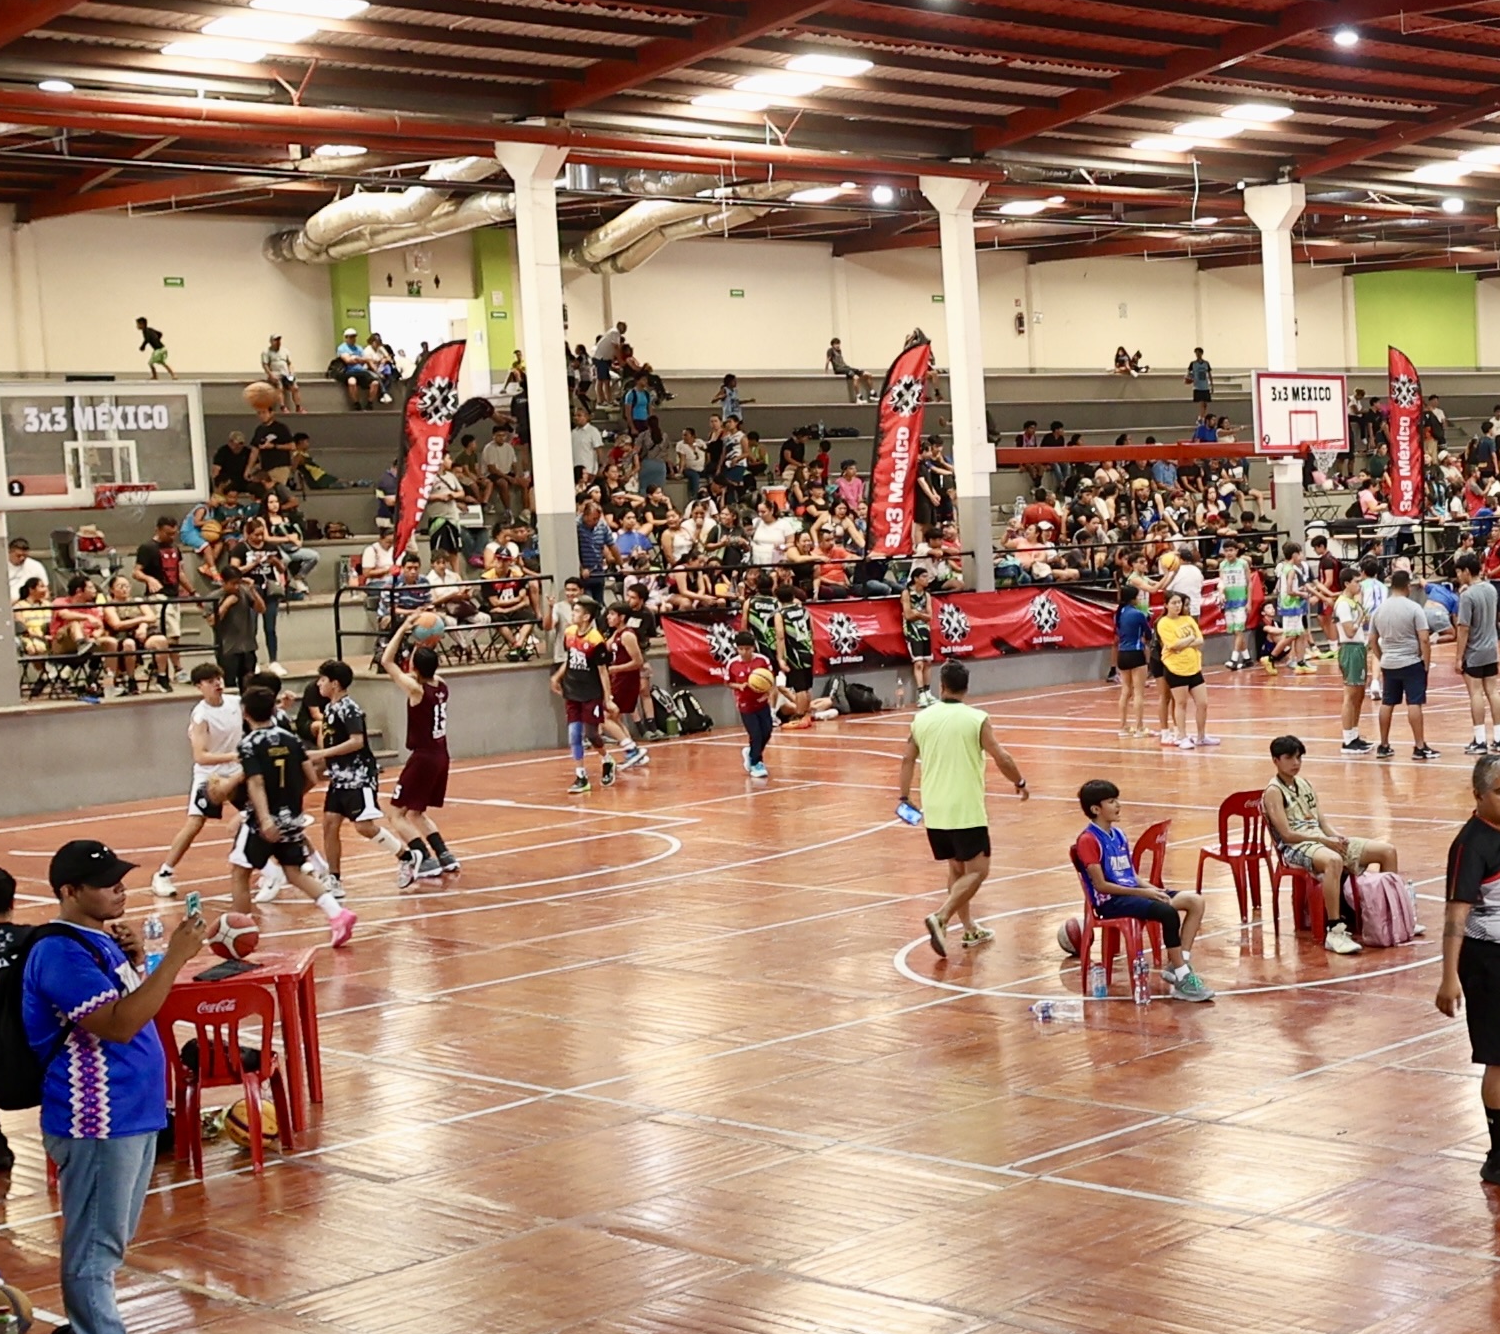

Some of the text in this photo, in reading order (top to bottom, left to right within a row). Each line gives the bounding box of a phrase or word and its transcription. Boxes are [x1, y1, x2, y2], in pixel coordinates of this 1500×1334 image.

[23, 403, 169, 432] 3x3 MÉXICO
[887, 426, 910, 503] México
[274, 758, 286, 788] 7
